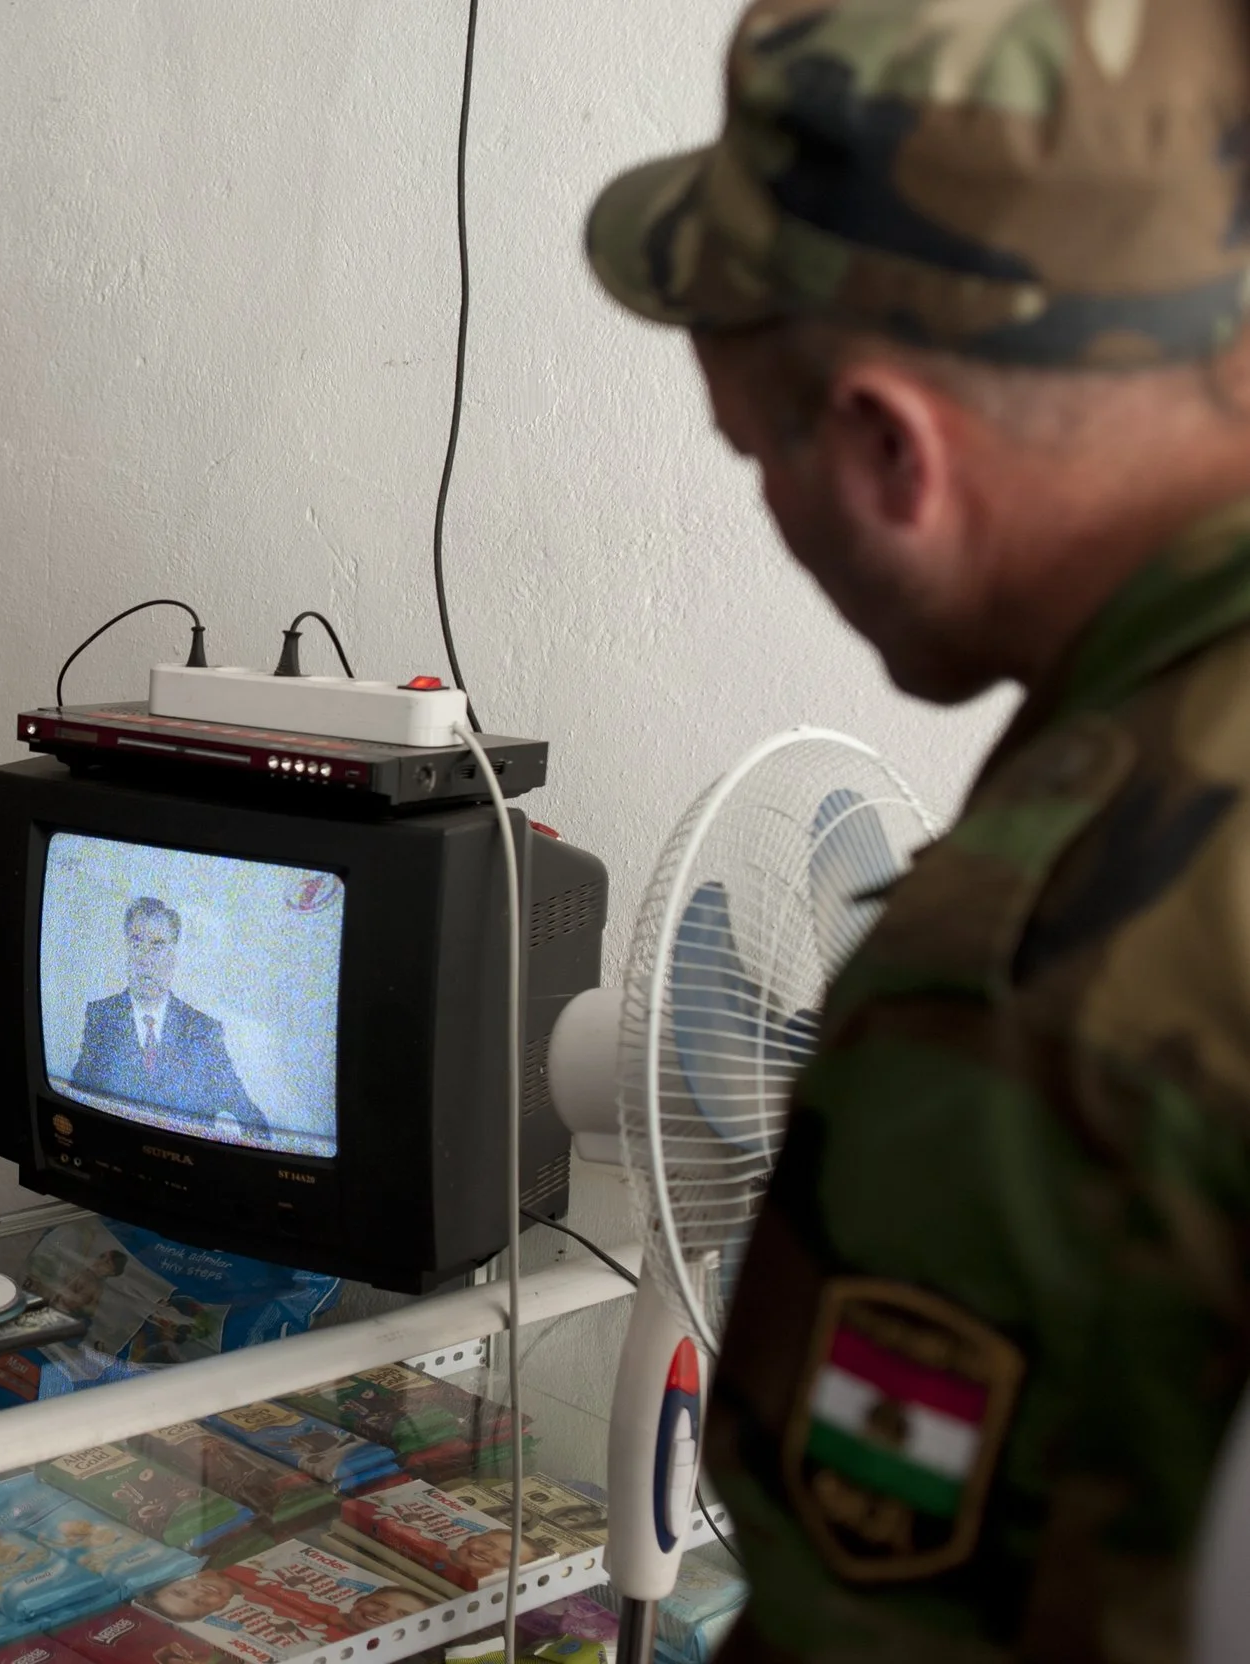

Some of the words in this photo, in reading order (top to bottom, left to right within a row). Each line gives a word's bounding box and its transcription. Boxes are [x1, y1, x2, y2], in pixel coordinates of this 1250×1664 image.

[141, 1144, 195, 1166] SUPRA
[186, 1265, 223, 1281] steps
[63, 1446, 103, 1466] Alpen
[75, 1451, 110, 1471] Gold
[422, 1487, 468, 1513] Kinder
[300, 1547, 350, 1572] Kinder
